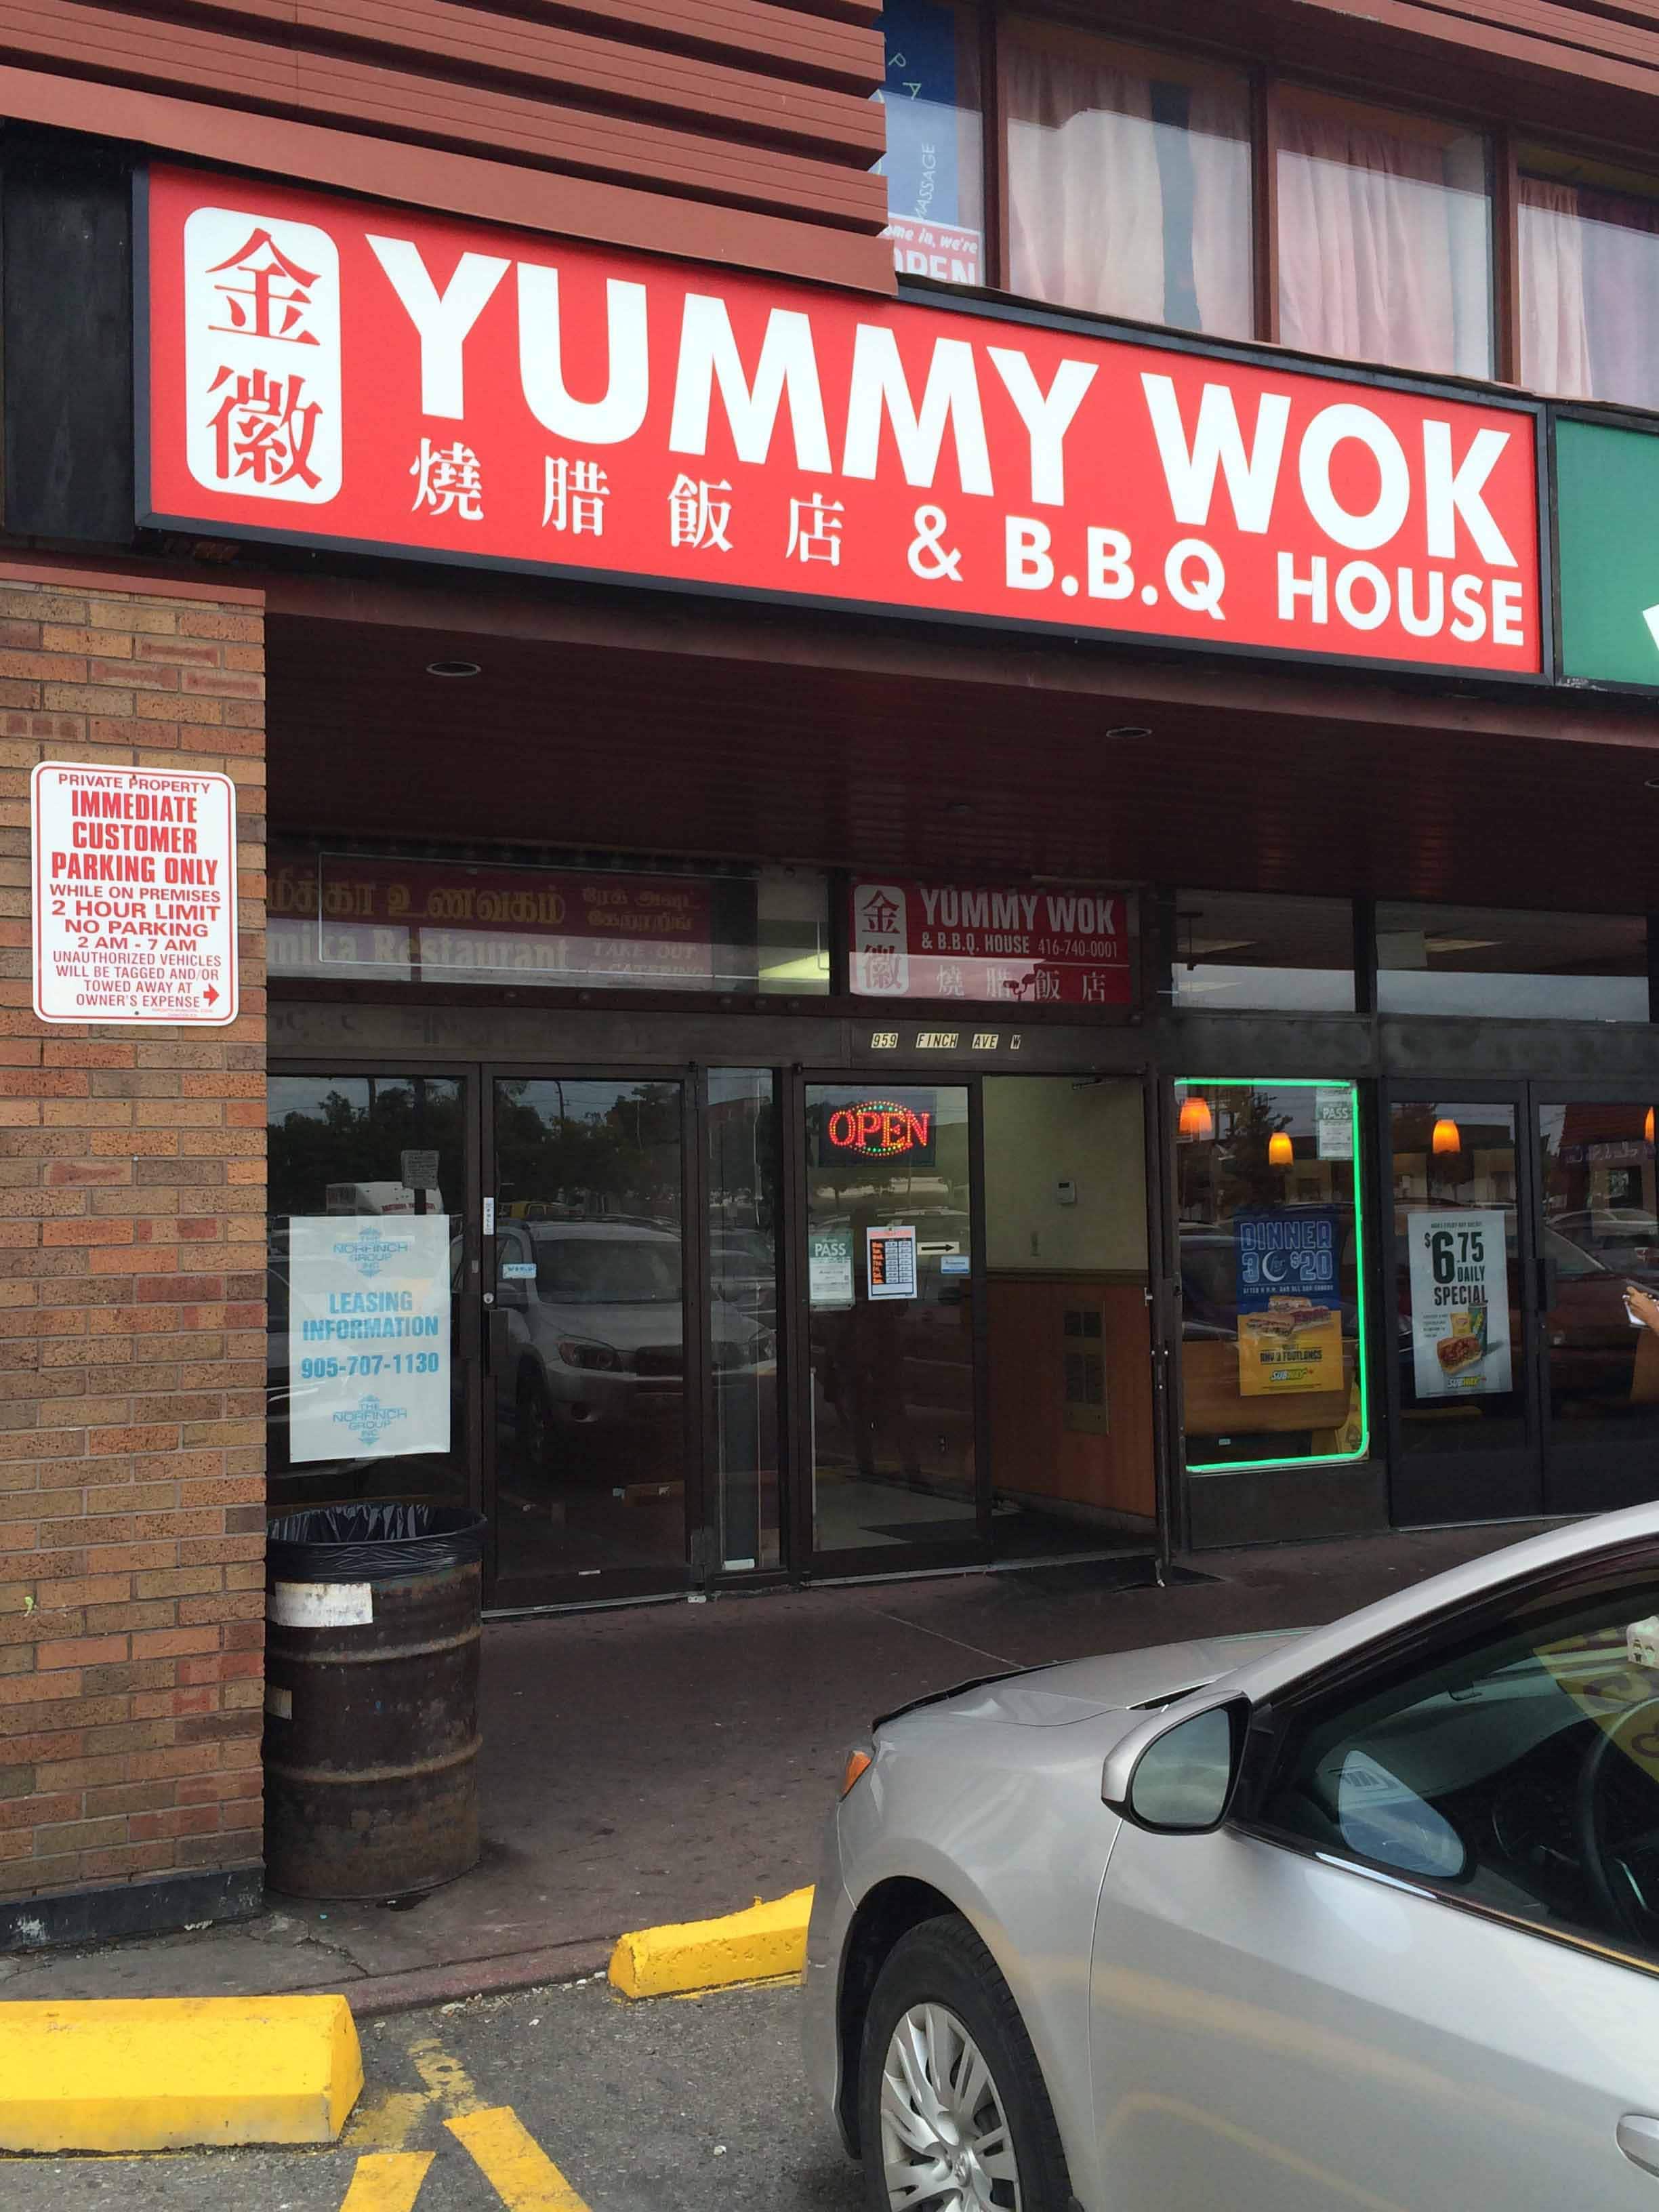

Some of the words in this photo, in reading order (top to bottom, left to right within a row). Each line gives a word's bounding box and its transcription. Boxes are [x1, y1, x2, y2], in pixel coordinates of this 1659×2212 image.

[883, 225, 914, 241] ome
[940, 236, 977, 254] we're
[205, 227, 324, 489] 金徽
[365, 232, 1099, 507] YUMMY
[1140, 371, 1519, 568] WOK
[409, 437, 845, 567] 燒腊飯店
[907, 505, 963, 582] &
[1005, 514, 1226, 621] B.B.Q
[1277, 552, 1525, 647] HOUSE
[58, 774, 123, 789] PRIVATE
[129, 778, 210, 794] PROPERTY
[71, 790, 197, 823] IMMEDIATE
[73, 821, 197, 854] CUSTOMER
[52, 852, 155, 883] PARKING
[164, 857, 218, 886] ONLY
[49, 884, 103, 898] WHILE
[108, 886, 134, 900] ON
[139, 888, 221, 902] PREMISES
[52, 900, 66, 916] 2
[75, 901, 146, 919] HOUR
[155, 903, 221, 921] LIMIT
[920, 888, 1038, 931] YUMMY
[1047, 896, 1116, 935] WOK
[65, 920, 100, 934] NO
[108, 921, 208, 937] PARKING
[861, 890, 902, 989] 金徽
[77, 937, 89, 949] 2
[95, 937, 128, 949] AM
[148, 939, 159, 951] 7
[164, 939, 197, 951] AM
[373, 927, 569, 969] Restaurant
[592, 942, 645, 958] TAKE
[657, 945, 698, 960] OUT
[921, 932, 933, 949] &
[985, 935, 1029, 954] HOUSE
[1038, 938, 1118, 958] 416-740-0001
[53, 951, 155, 965] UNAUTHORIZED
[160, 954, 222, 967] VEHICLES
[56, 966, 89, 978] WILL
[94, 966, 110, 979] BE
[116, 966, 165, 979] TAGGED
[169, 968, 219, 981] AND/OR
[84, 979, 131, 992] TOWED
[136, 981, 173, 994] AWAY
[178, 982, 192, 994] AT
[77, 994, 138, 1007] OWNER'S
[143, 995, 200, 1008] EXPENSE
[872, 1033, 898, 1048] 959
[917, 1033, 958, 1048] FINCH
[972, 1034, 998, 1049] AVE
[1322, 1107, 1349, 1120] PASS
[829, 1110, 930, 1147] OPEN
[1240, 1220, 1333, 1252] DINNER
[815, 1242, 846, 1257] PASS
[1242, 1251, 1259, 1283] 3
[1290, 1250, 1333, 1282] $20
[1457, 1265, 1486, 1283] DAILY
[329, 1291, 413, 1315] LEASING
[1434, 1284, 1488, 1307] SPECIAL
[302, 1316, 439, 1341] INFORMATION
[301, 1352, 439, 1379] 905-707-1130
